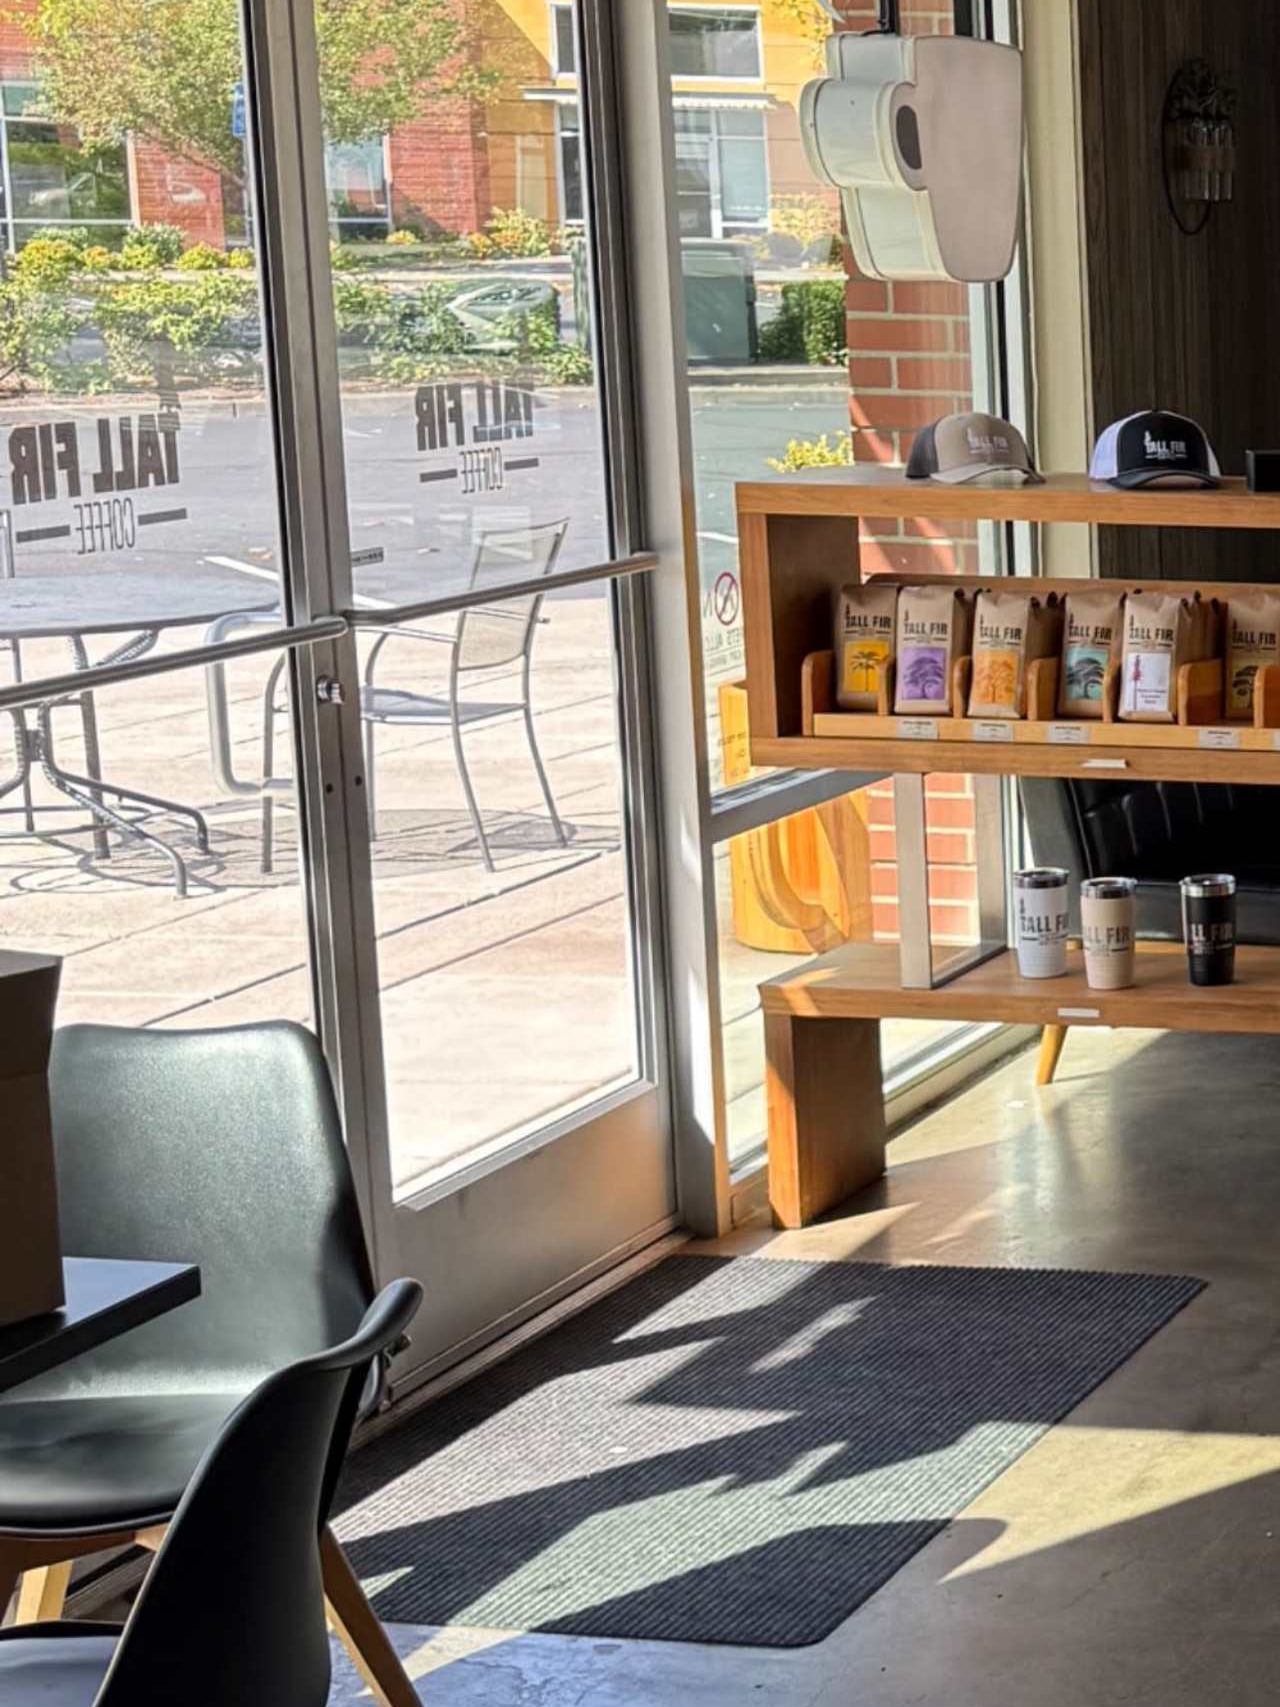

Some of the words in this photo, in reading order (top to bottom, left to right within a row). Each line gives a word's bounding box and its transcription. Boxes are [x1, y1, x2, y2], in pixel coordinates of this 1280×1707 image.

[846, 614, 869, 628] TALL
[873, 615, 892, 629] FIR
[904, 622, 926, 634] TALL
[930, 622, 948, 635] FIR
[980, 626, 1000, 638] TALL
[1004, 626, 1022, 640] FIR
[1069, 625, 1091, 638] TALL
[1094, 627, 1112, 640] FIR
[1129, 628, 1152, 640] TALL
[1155, 628, 1174, 641] FIR
[1232, 631, 1255, 644] TALL
[1259, 632, 1276, 644] FIR
[1020, 915, 1052, 932] TALL
[1106, 925, 1130, 943] FIR
